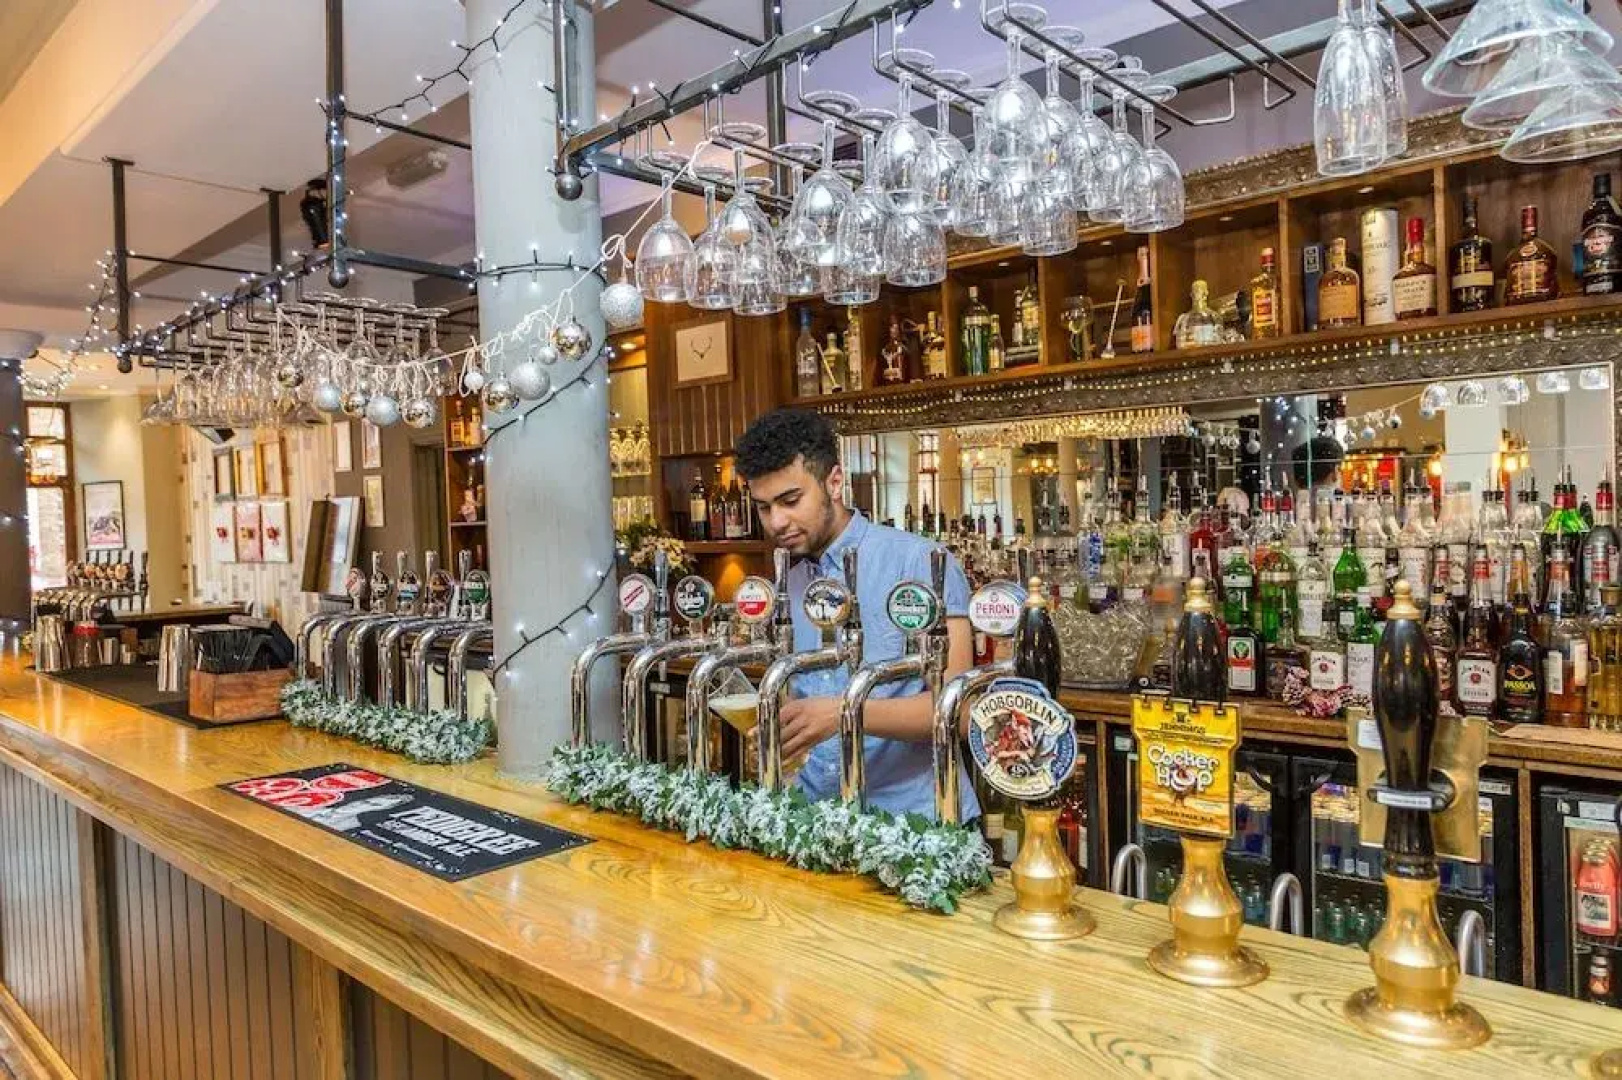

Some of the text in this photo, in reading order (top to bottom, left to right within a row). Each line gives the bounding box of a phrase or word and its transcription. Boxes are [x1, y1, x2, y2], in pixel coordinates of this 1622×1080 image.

[975, 602, 1016, 614] PERONI
[980, 694, 1057, 724] HOBGOBLIN
[389, 806, 541, 855] PEDIGREE
